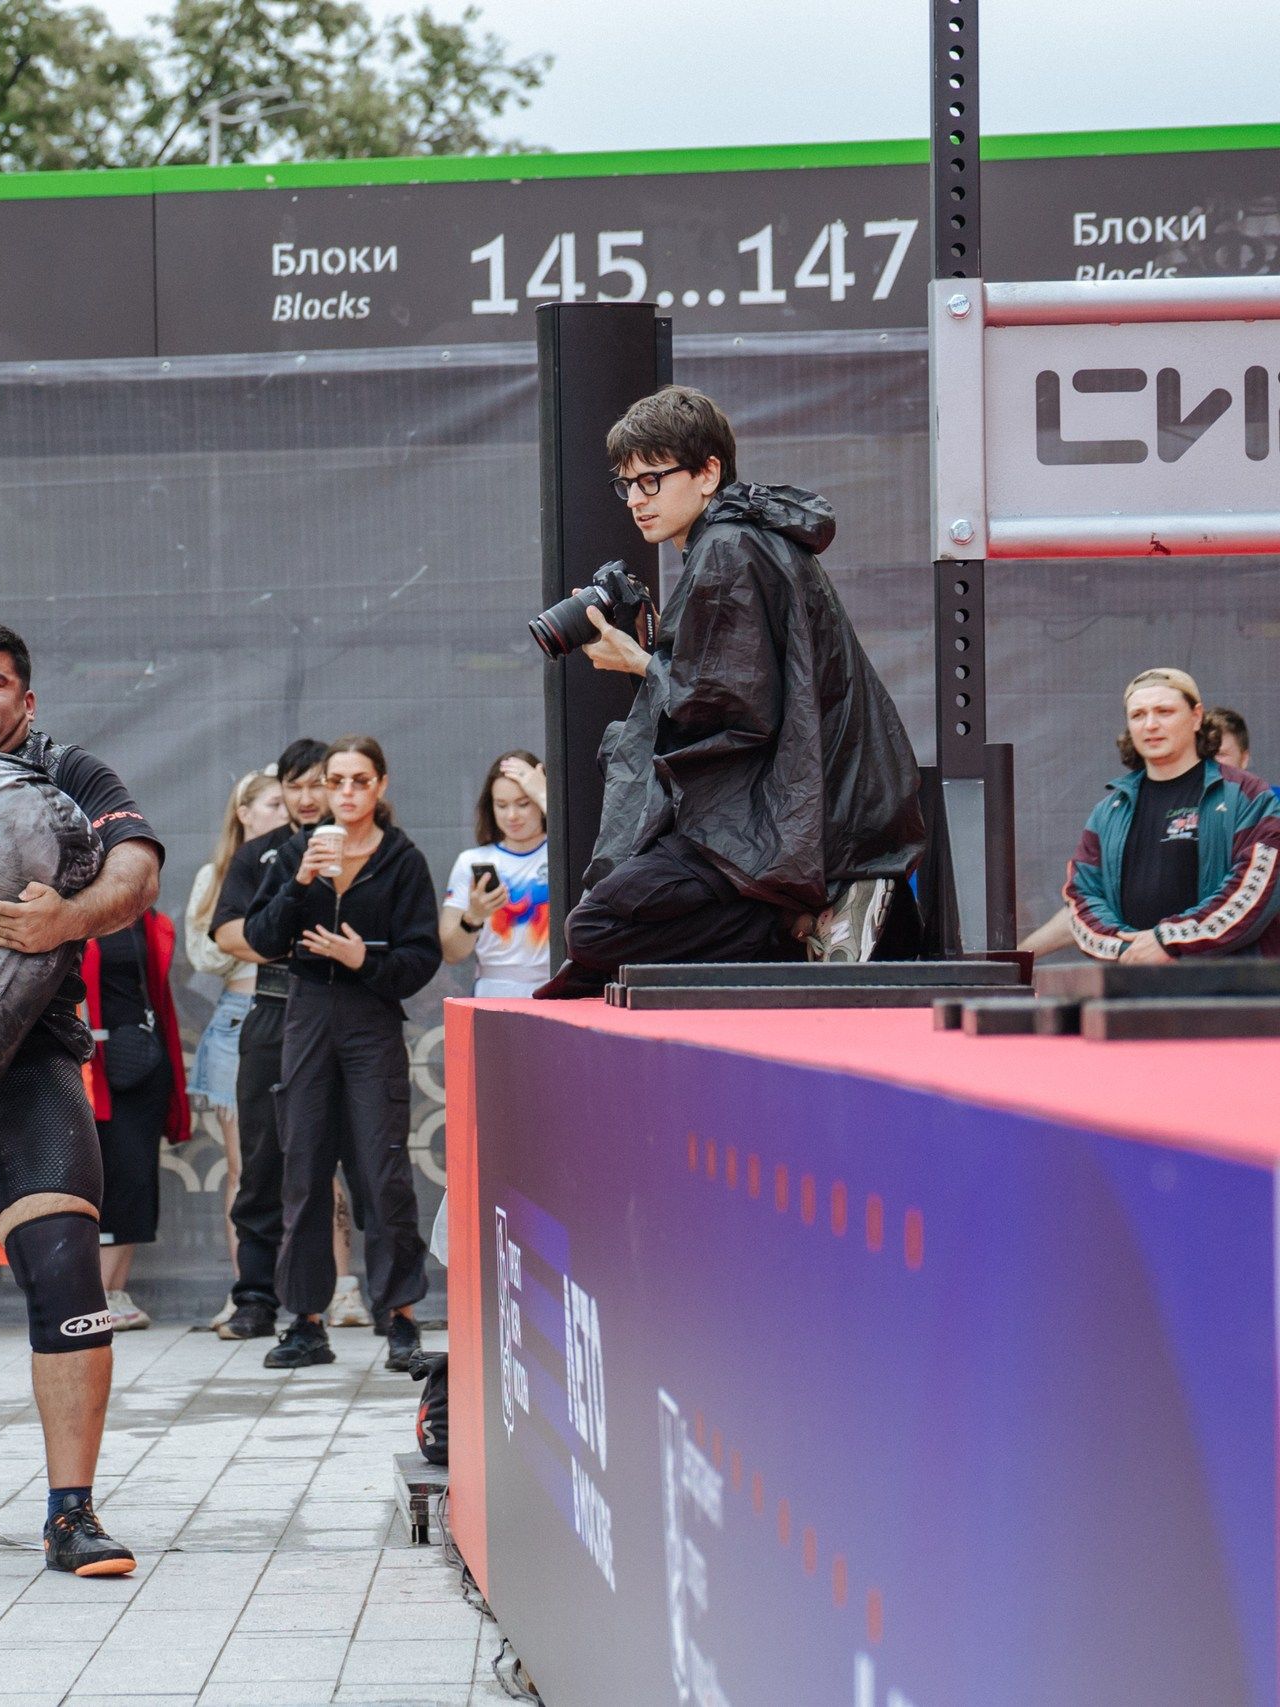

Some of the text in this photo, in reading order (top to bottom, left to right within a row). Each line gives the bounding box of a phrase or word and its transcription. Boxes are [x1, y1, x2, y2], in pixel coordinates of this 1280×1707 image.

[1073, 211, 1207, 247] Блоки
[271, 242, 399, 277] Блоки
[272, 290, 371, 322] Blocks
[1035, 365, 1280, 466] СИ
